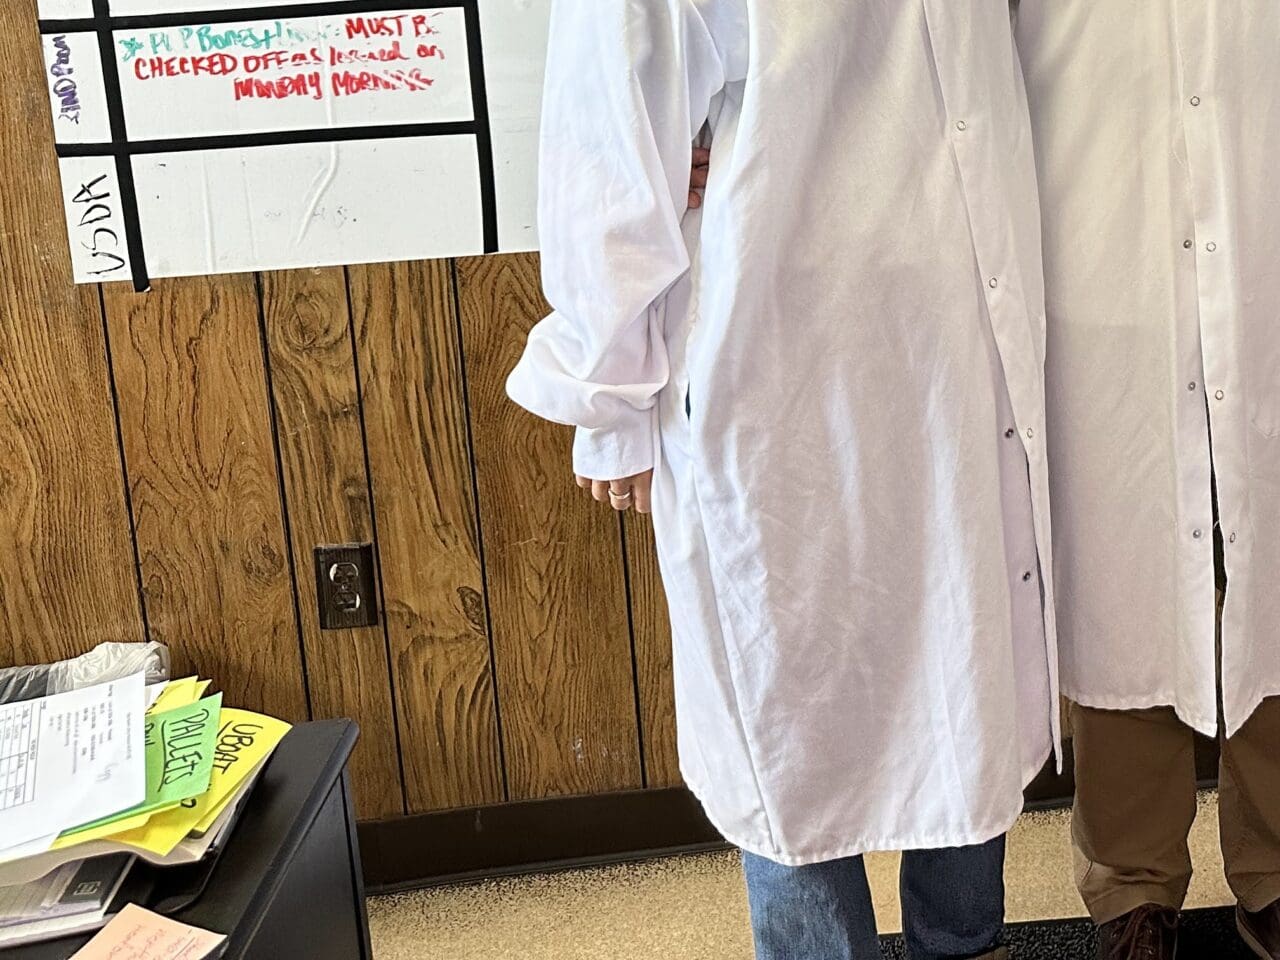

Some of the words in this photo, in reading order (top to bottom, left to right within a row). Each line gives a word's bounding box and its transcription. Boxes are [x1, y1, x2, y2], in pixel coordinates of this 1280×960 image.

[345, 12, 409, 40] MUST
[134, 52, 238, 81] CHECKED
[72, 173, 126, 276] USDA
[163, 708, 211, 786] PALLETS
[213, 722, 265, 776] UBOAT
